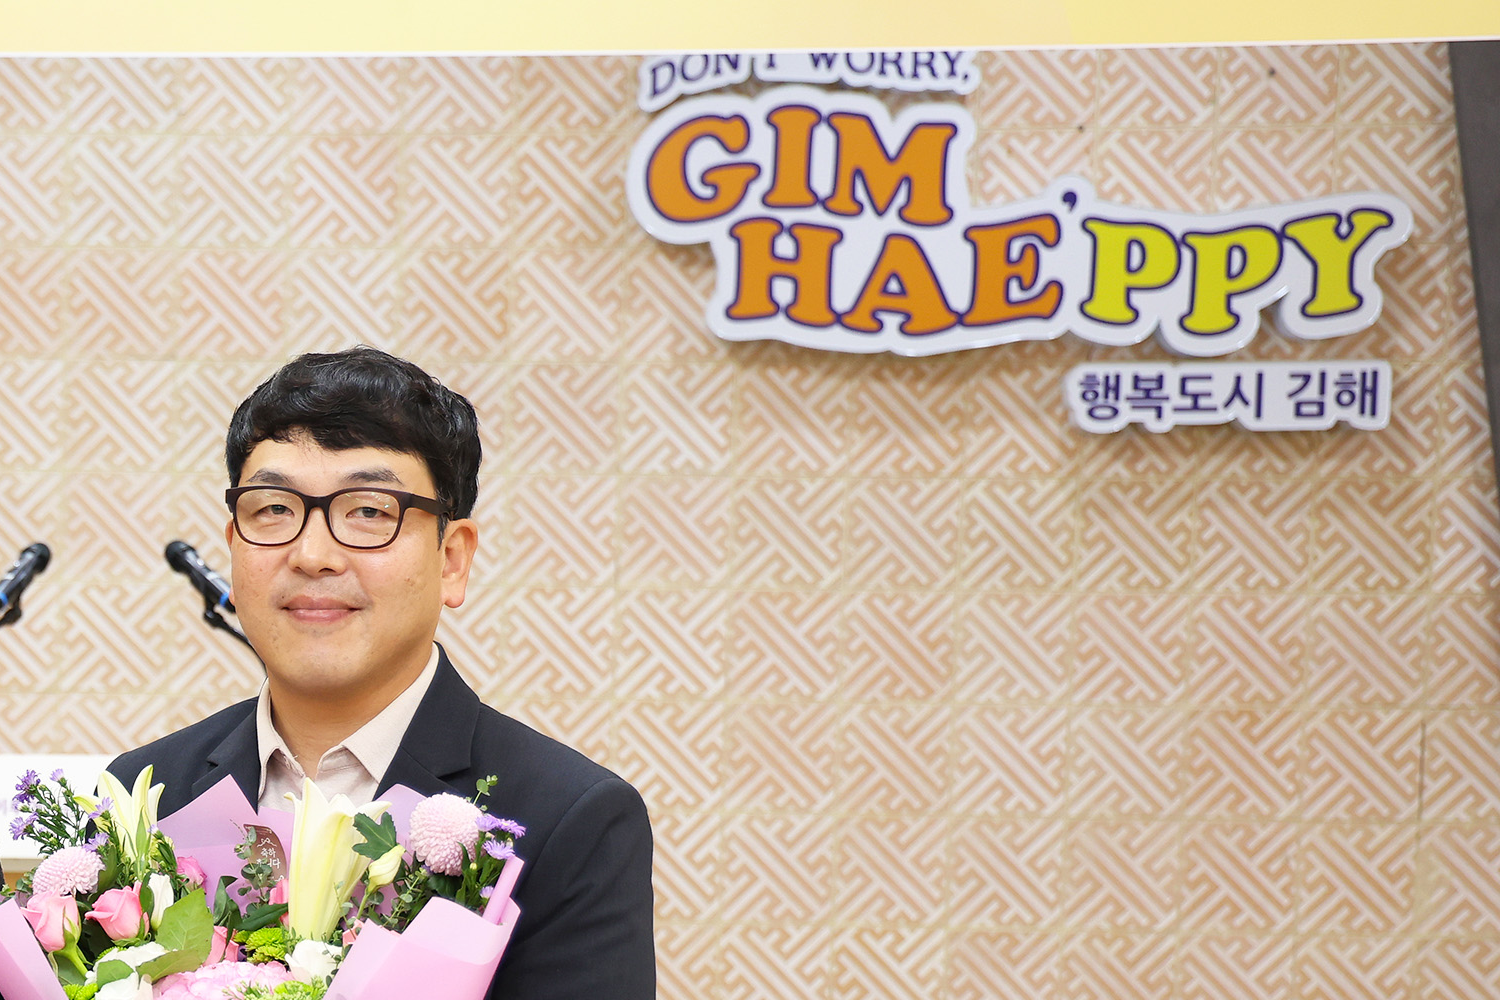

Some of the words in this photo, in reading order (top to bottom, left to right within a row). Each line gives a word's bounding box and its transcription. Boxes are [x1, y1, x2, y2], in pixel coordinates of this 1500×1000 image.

[646, 104, 958, 227] GIM
[1079, 371, 1265, 420] 행복도시
[1287, 370, 1379, 419] 김해
